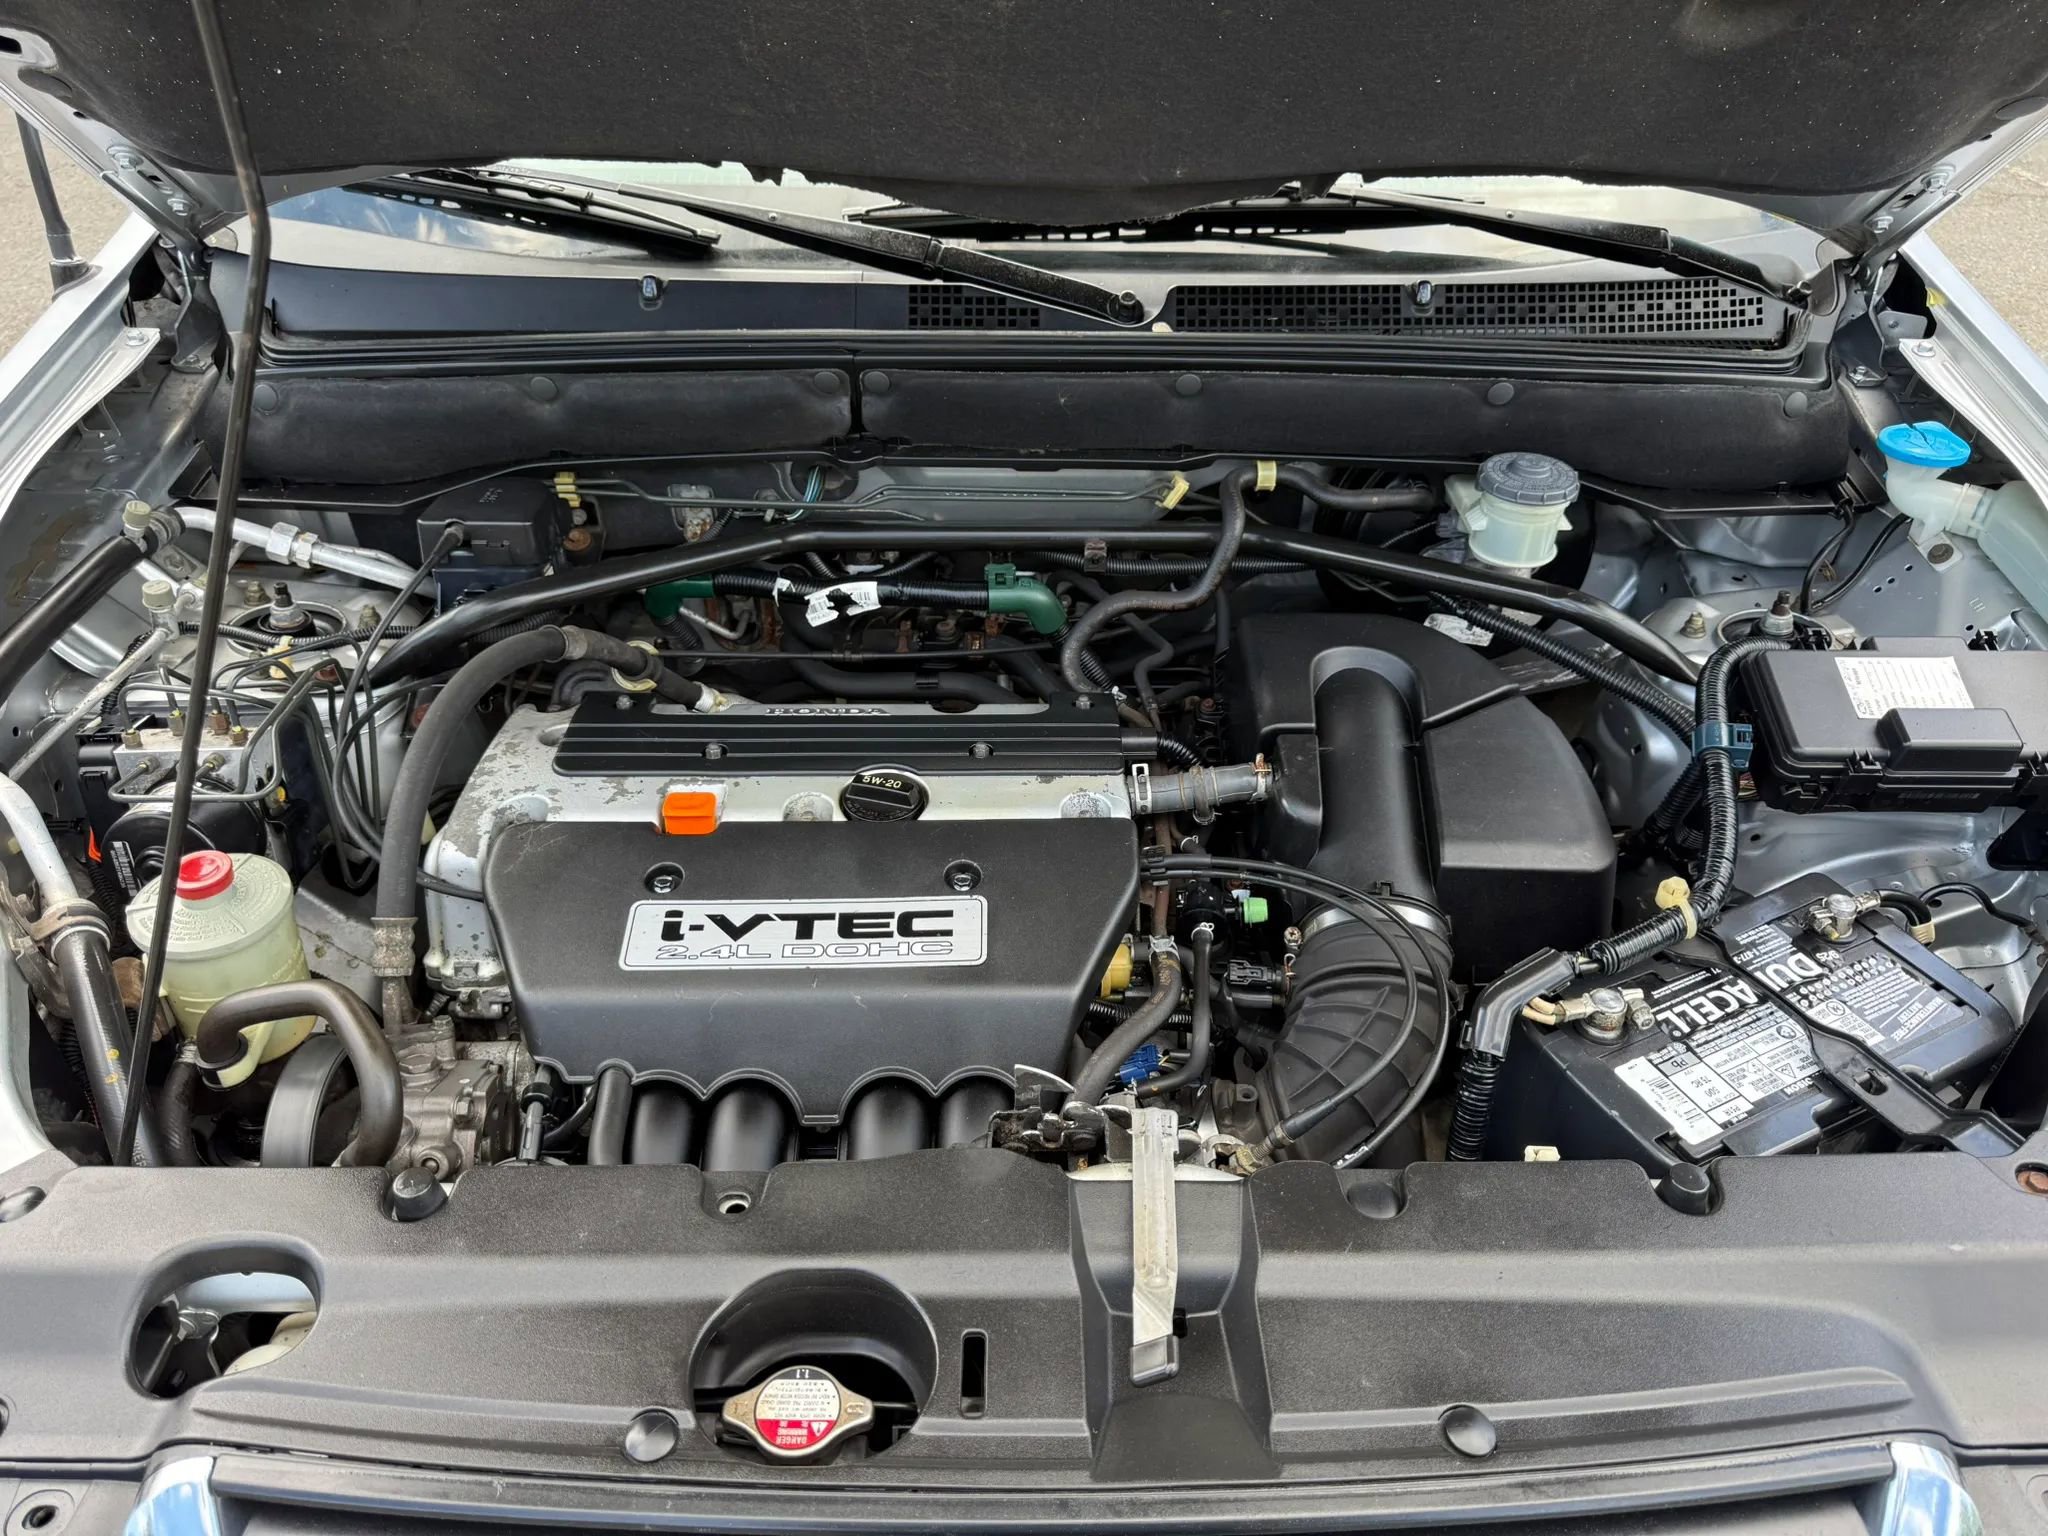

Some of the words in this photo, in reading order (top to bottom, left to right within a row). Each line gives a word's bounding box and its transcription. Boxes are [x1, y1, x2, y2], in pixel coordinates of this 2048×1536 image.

[765, 707, 891, 716] HONDA
[862, 775, 902, 789] 5W-20
[661, 909, 954, 942] i-VTEC
[656, 944, 771, 960] 2.4L
[781, 941, 954, 959] DOHC
[1815, 950, 1839, 962] 9/25
[1655, 951, 1823, 1035] DUACELL
[1670, 1056, 1688, 1070] Pb
[796, 1369, 809, 1378] 1.1
[776, 1436, 808, 1444] DANGER
